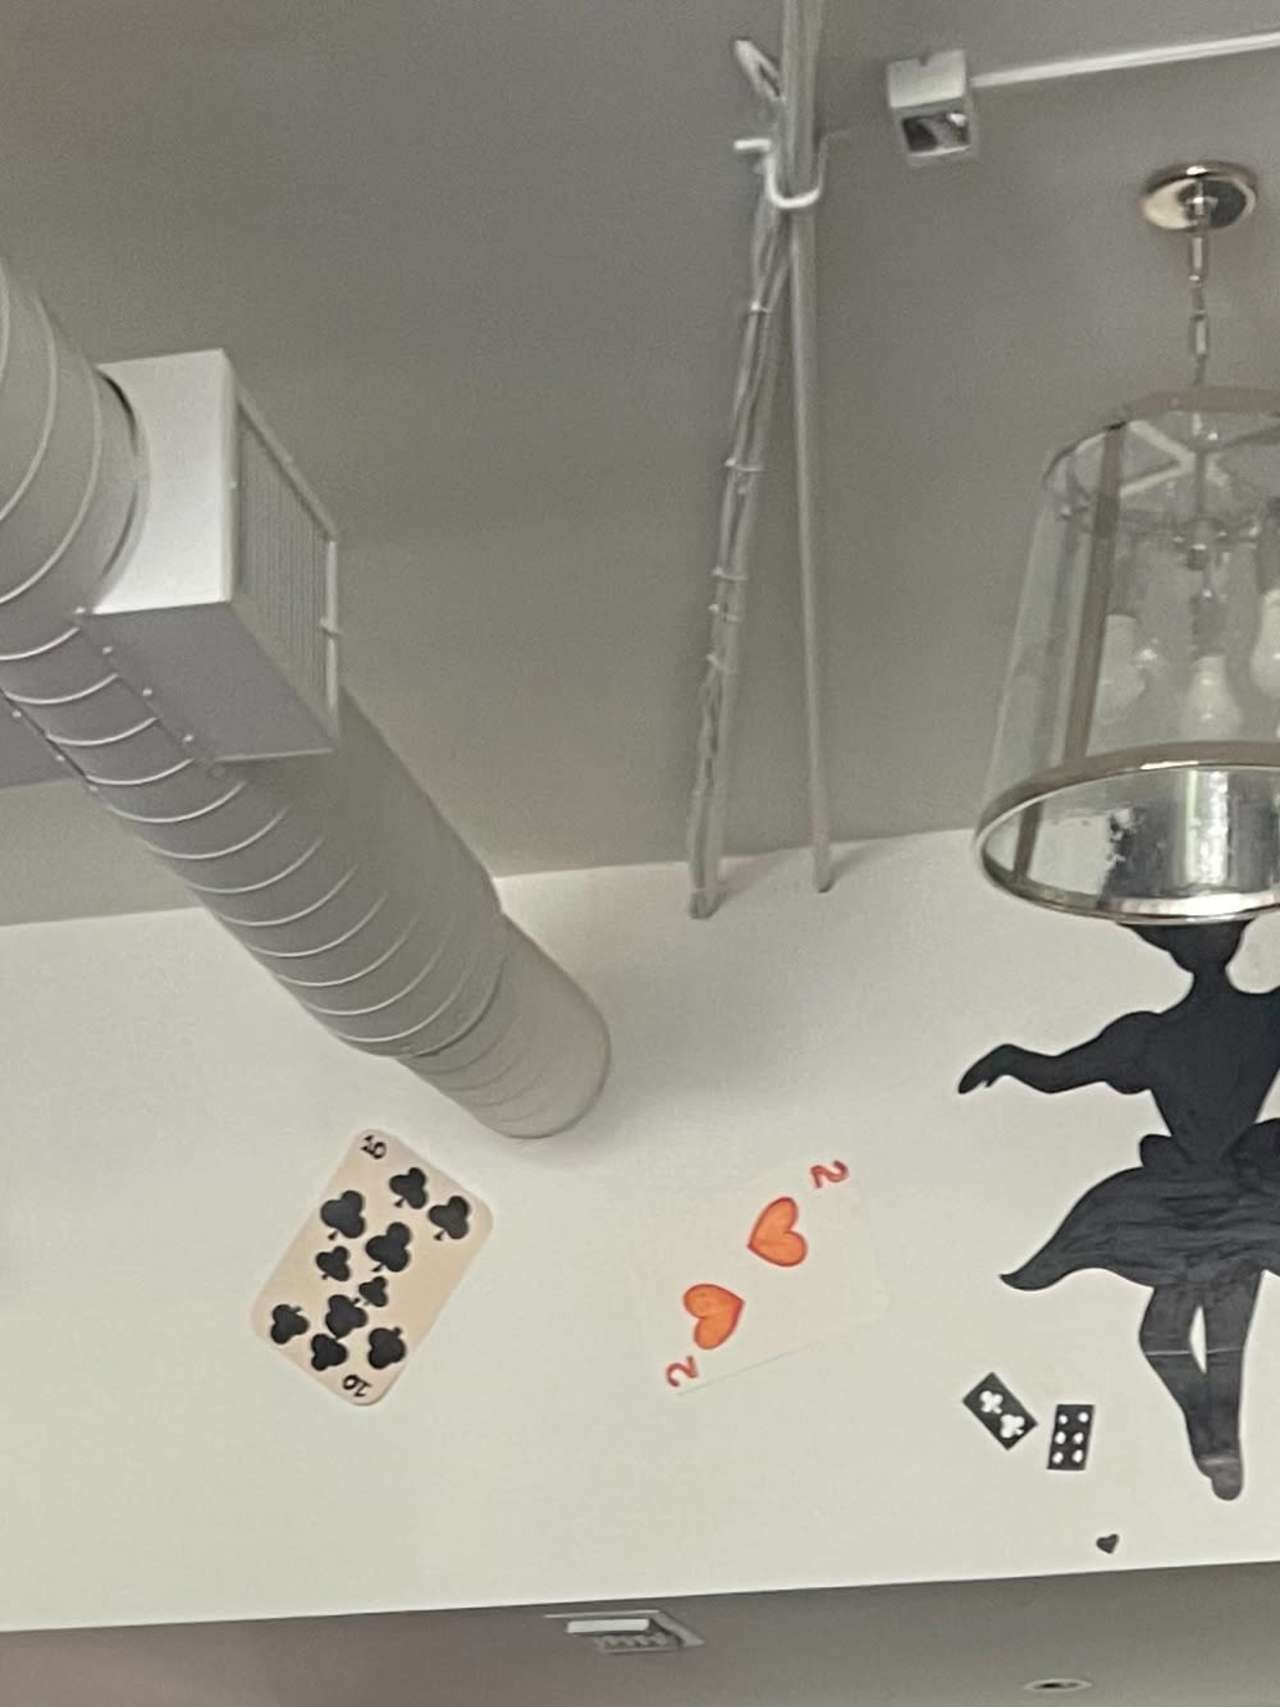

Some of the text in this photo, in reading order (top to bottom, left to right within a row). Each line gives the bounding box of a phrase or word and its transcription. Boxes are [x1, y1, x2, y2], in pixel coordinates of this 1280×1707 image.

[361, 1134, 388, 1160] 10
[809, 1159, 849, 1189] 2
[664, 1354, 699, 1388] 2
